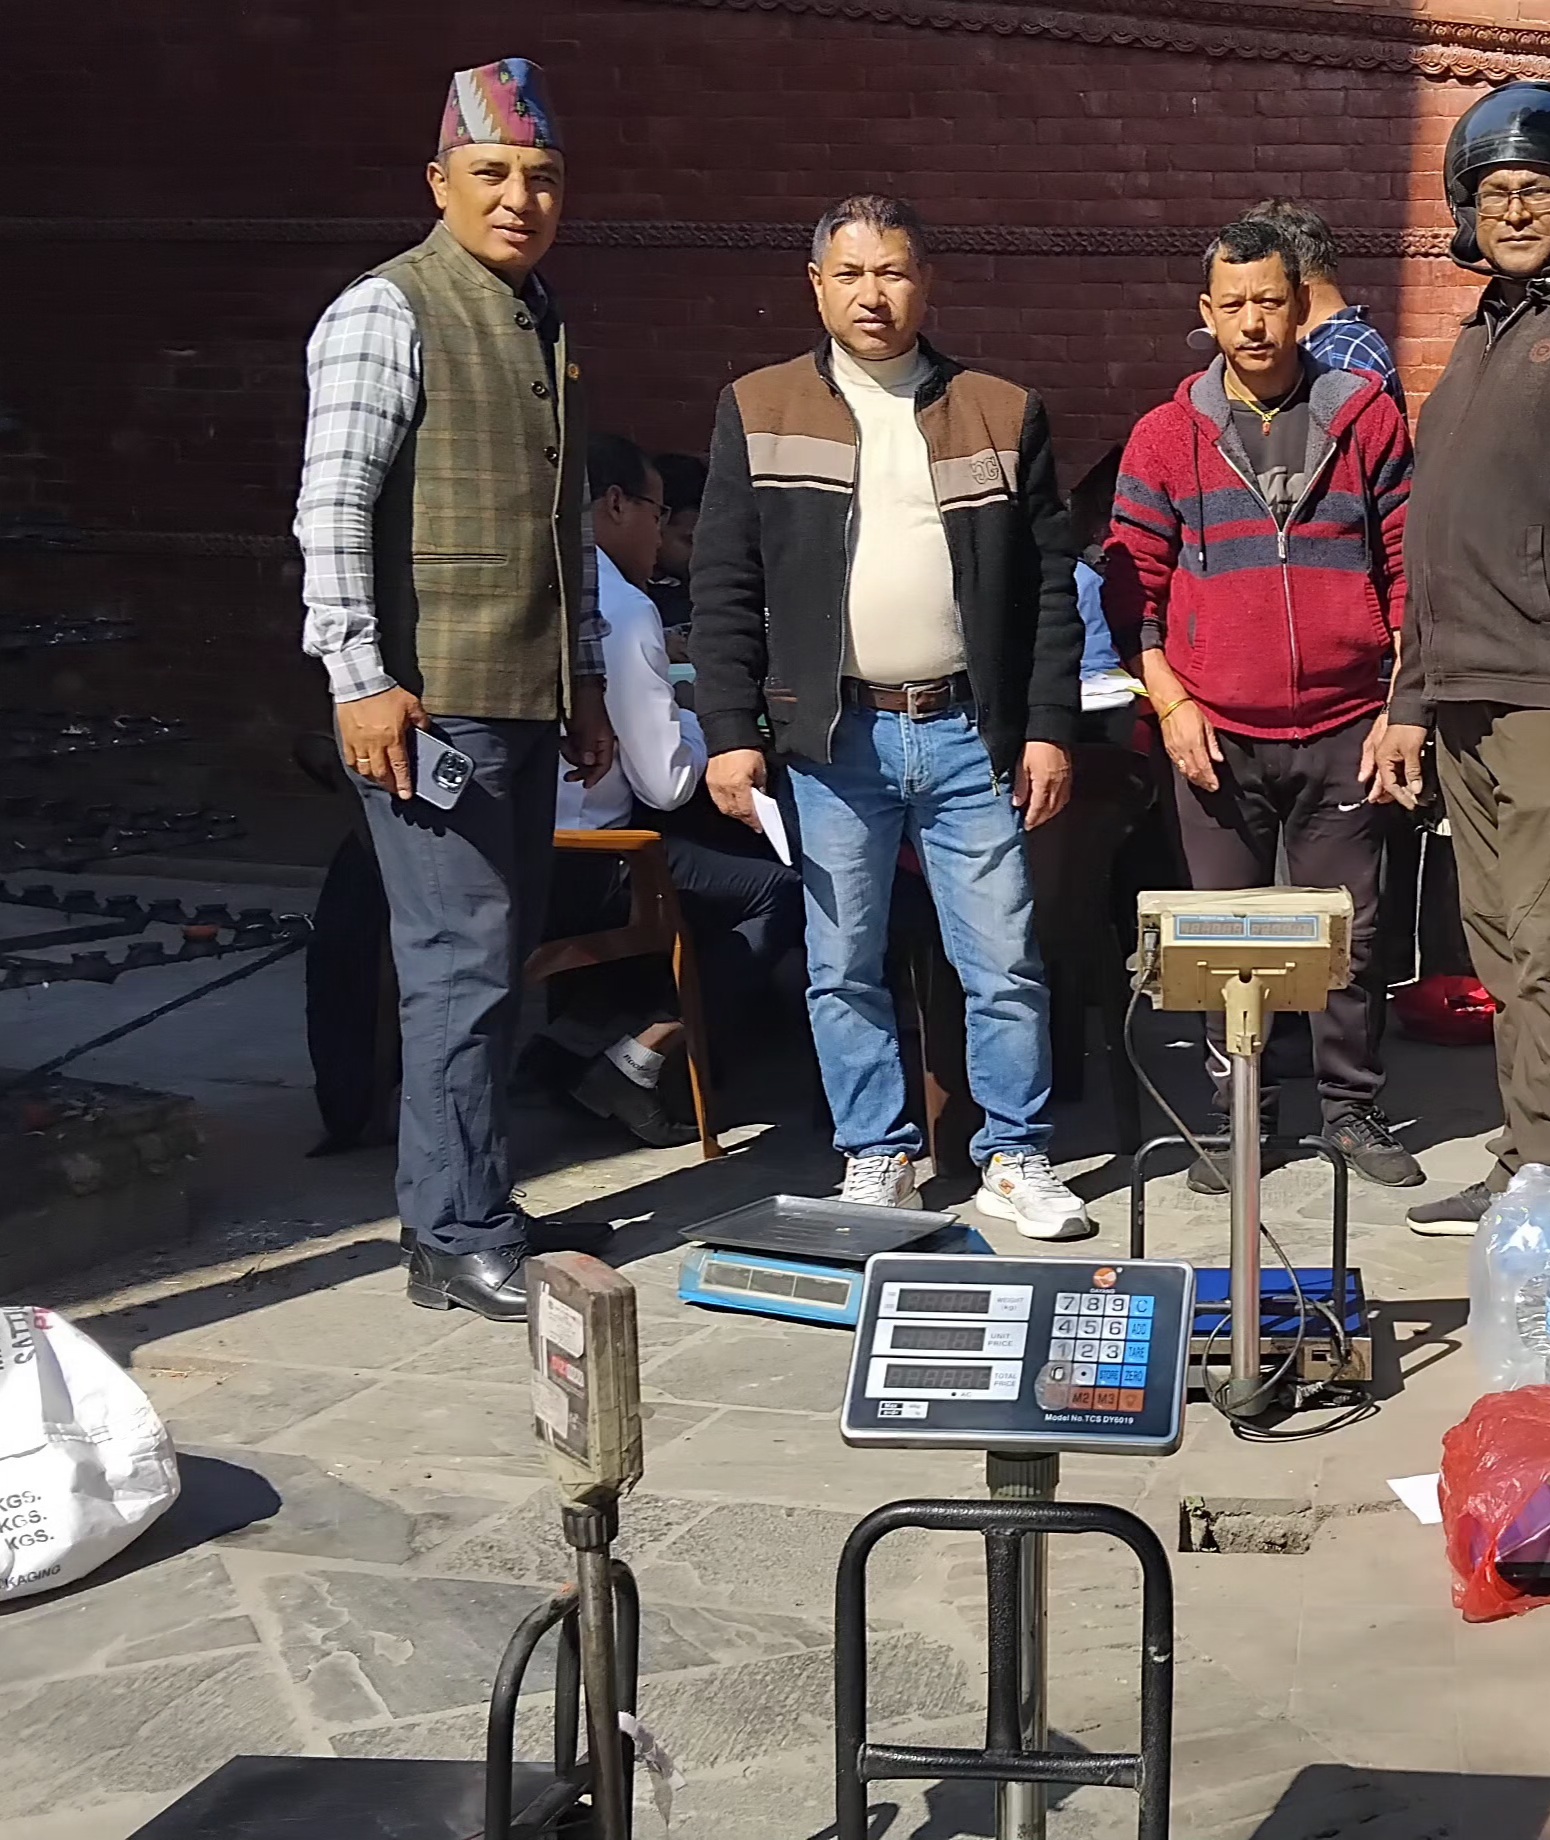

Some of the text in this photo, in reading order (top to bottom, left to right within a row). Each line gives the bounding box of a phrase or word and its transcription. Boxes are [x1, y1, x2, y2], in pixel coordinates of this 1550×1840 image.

[1063, 1296, 1148, 1313] 7 8 9 C
[1058, 1319, 1073, 1334] 4
[1083, 1320, 1097, 1335] 5
[1109, 1321, 1122, 1336] 6
[987, 1340, 1014, 1348] PRICE
[1057, 1343, 1145, 1359] 1 2 3 TARE
[994, 1372, 1018, 1380] TOTAL
[1124, 1369, 1143, 1382] ZERO
[993, 1380, 1017, 1388] PRICE
[1072, 1392, 1116, 1405] M2 M3
[1044, 1413, 1070, 1422] Model
[4, 1529, 54, 1551] KGS.
[0, 1564, 61, 1590] KAGING
